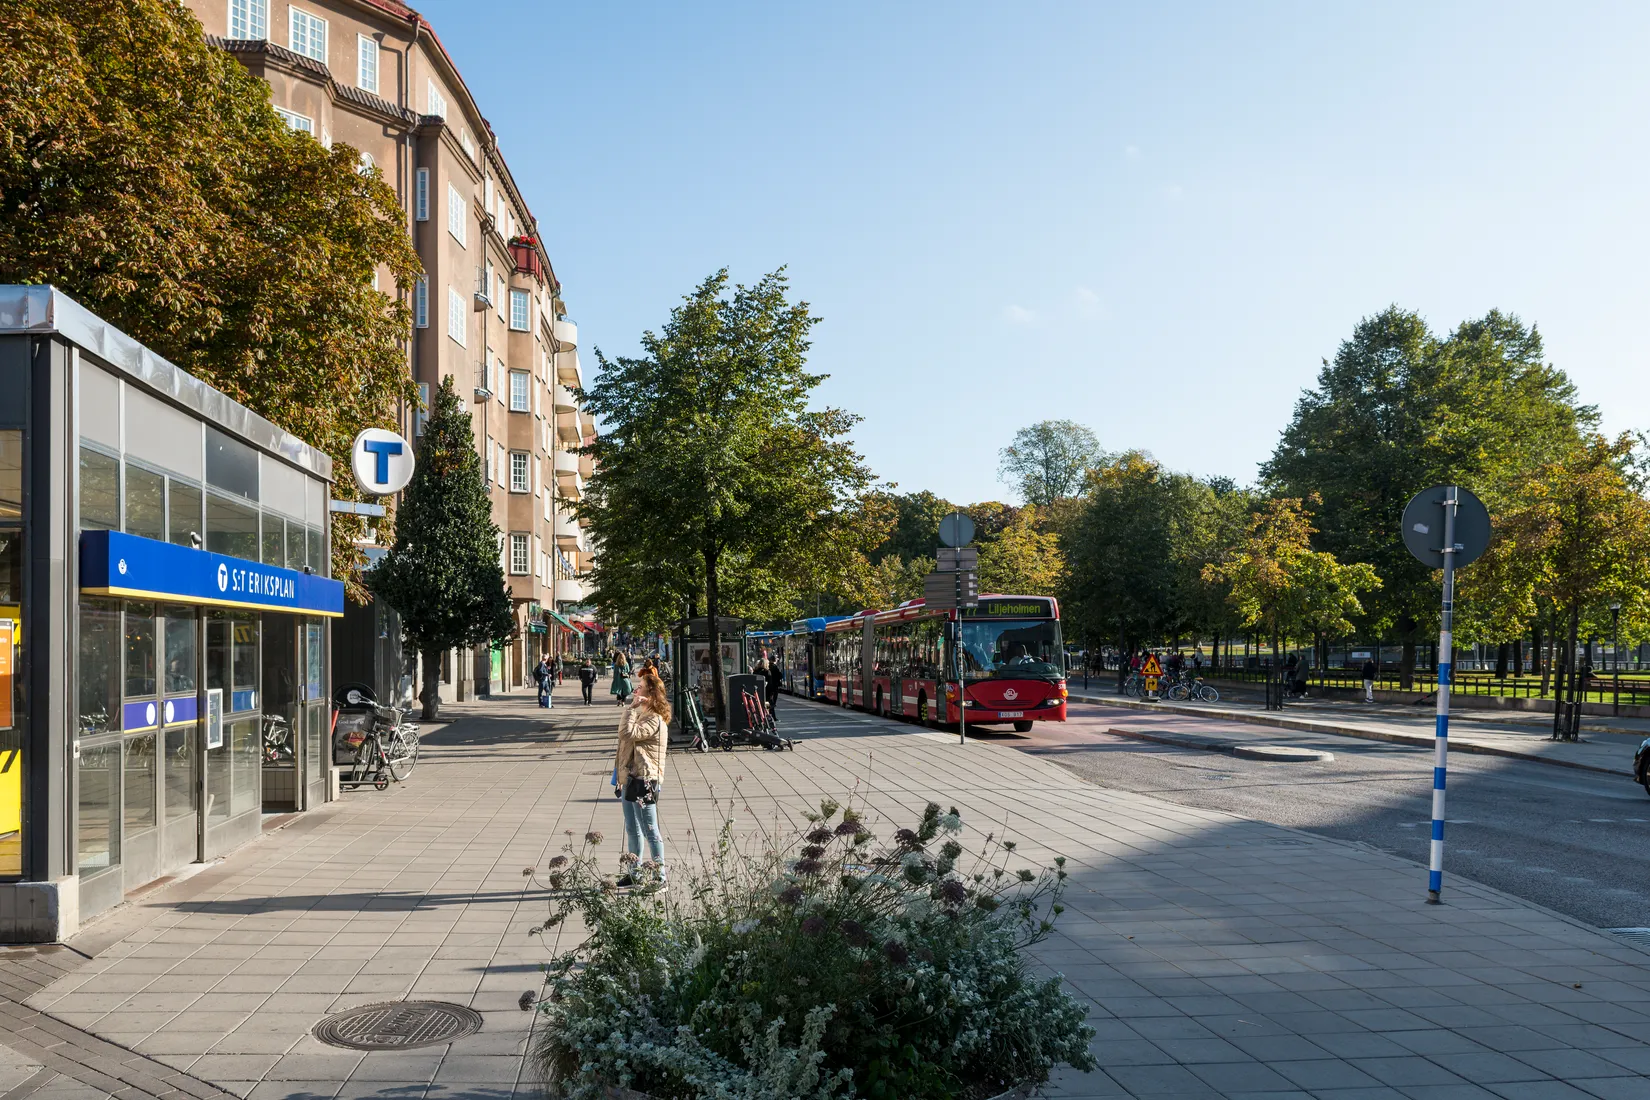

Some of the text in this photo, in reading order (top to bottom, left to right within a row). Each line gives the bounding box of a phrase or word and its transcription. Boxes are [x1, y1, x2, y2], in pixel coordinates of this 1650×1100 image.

[364, 440, 403, 484] T
[232, 568, 246, 592] S:T
[248, 571, 295, 599] ERIKSPLAN
[988, 603, 1041, 616] Liljeholmen
